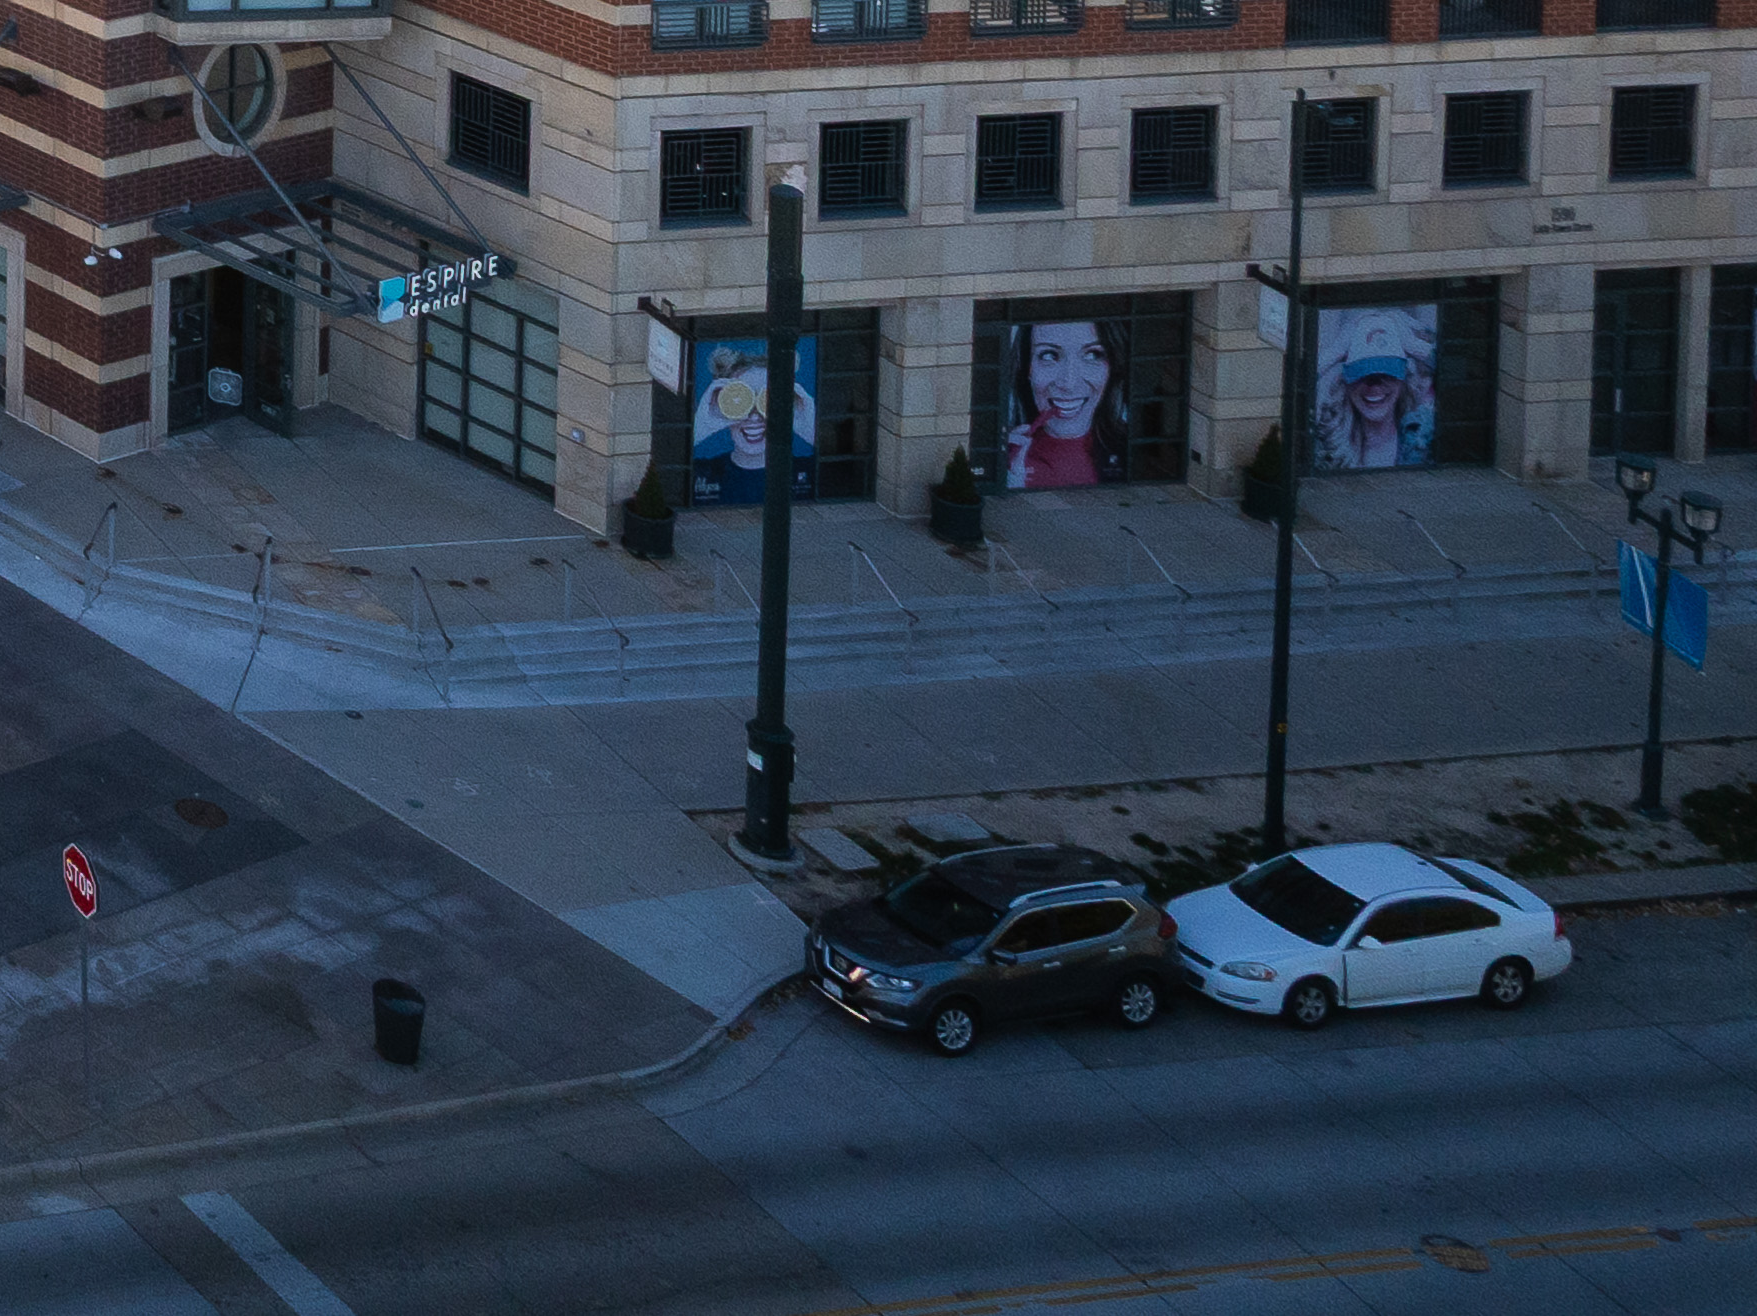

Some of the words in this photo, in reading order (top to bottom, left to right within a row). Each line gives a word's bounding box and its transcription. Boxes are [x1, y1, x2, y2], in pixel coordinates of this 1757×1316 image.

[410, 255, 499, 297] ESPIRE
[409, 286, 467, 318] dental
[66, 857, 94, 901] STOP
